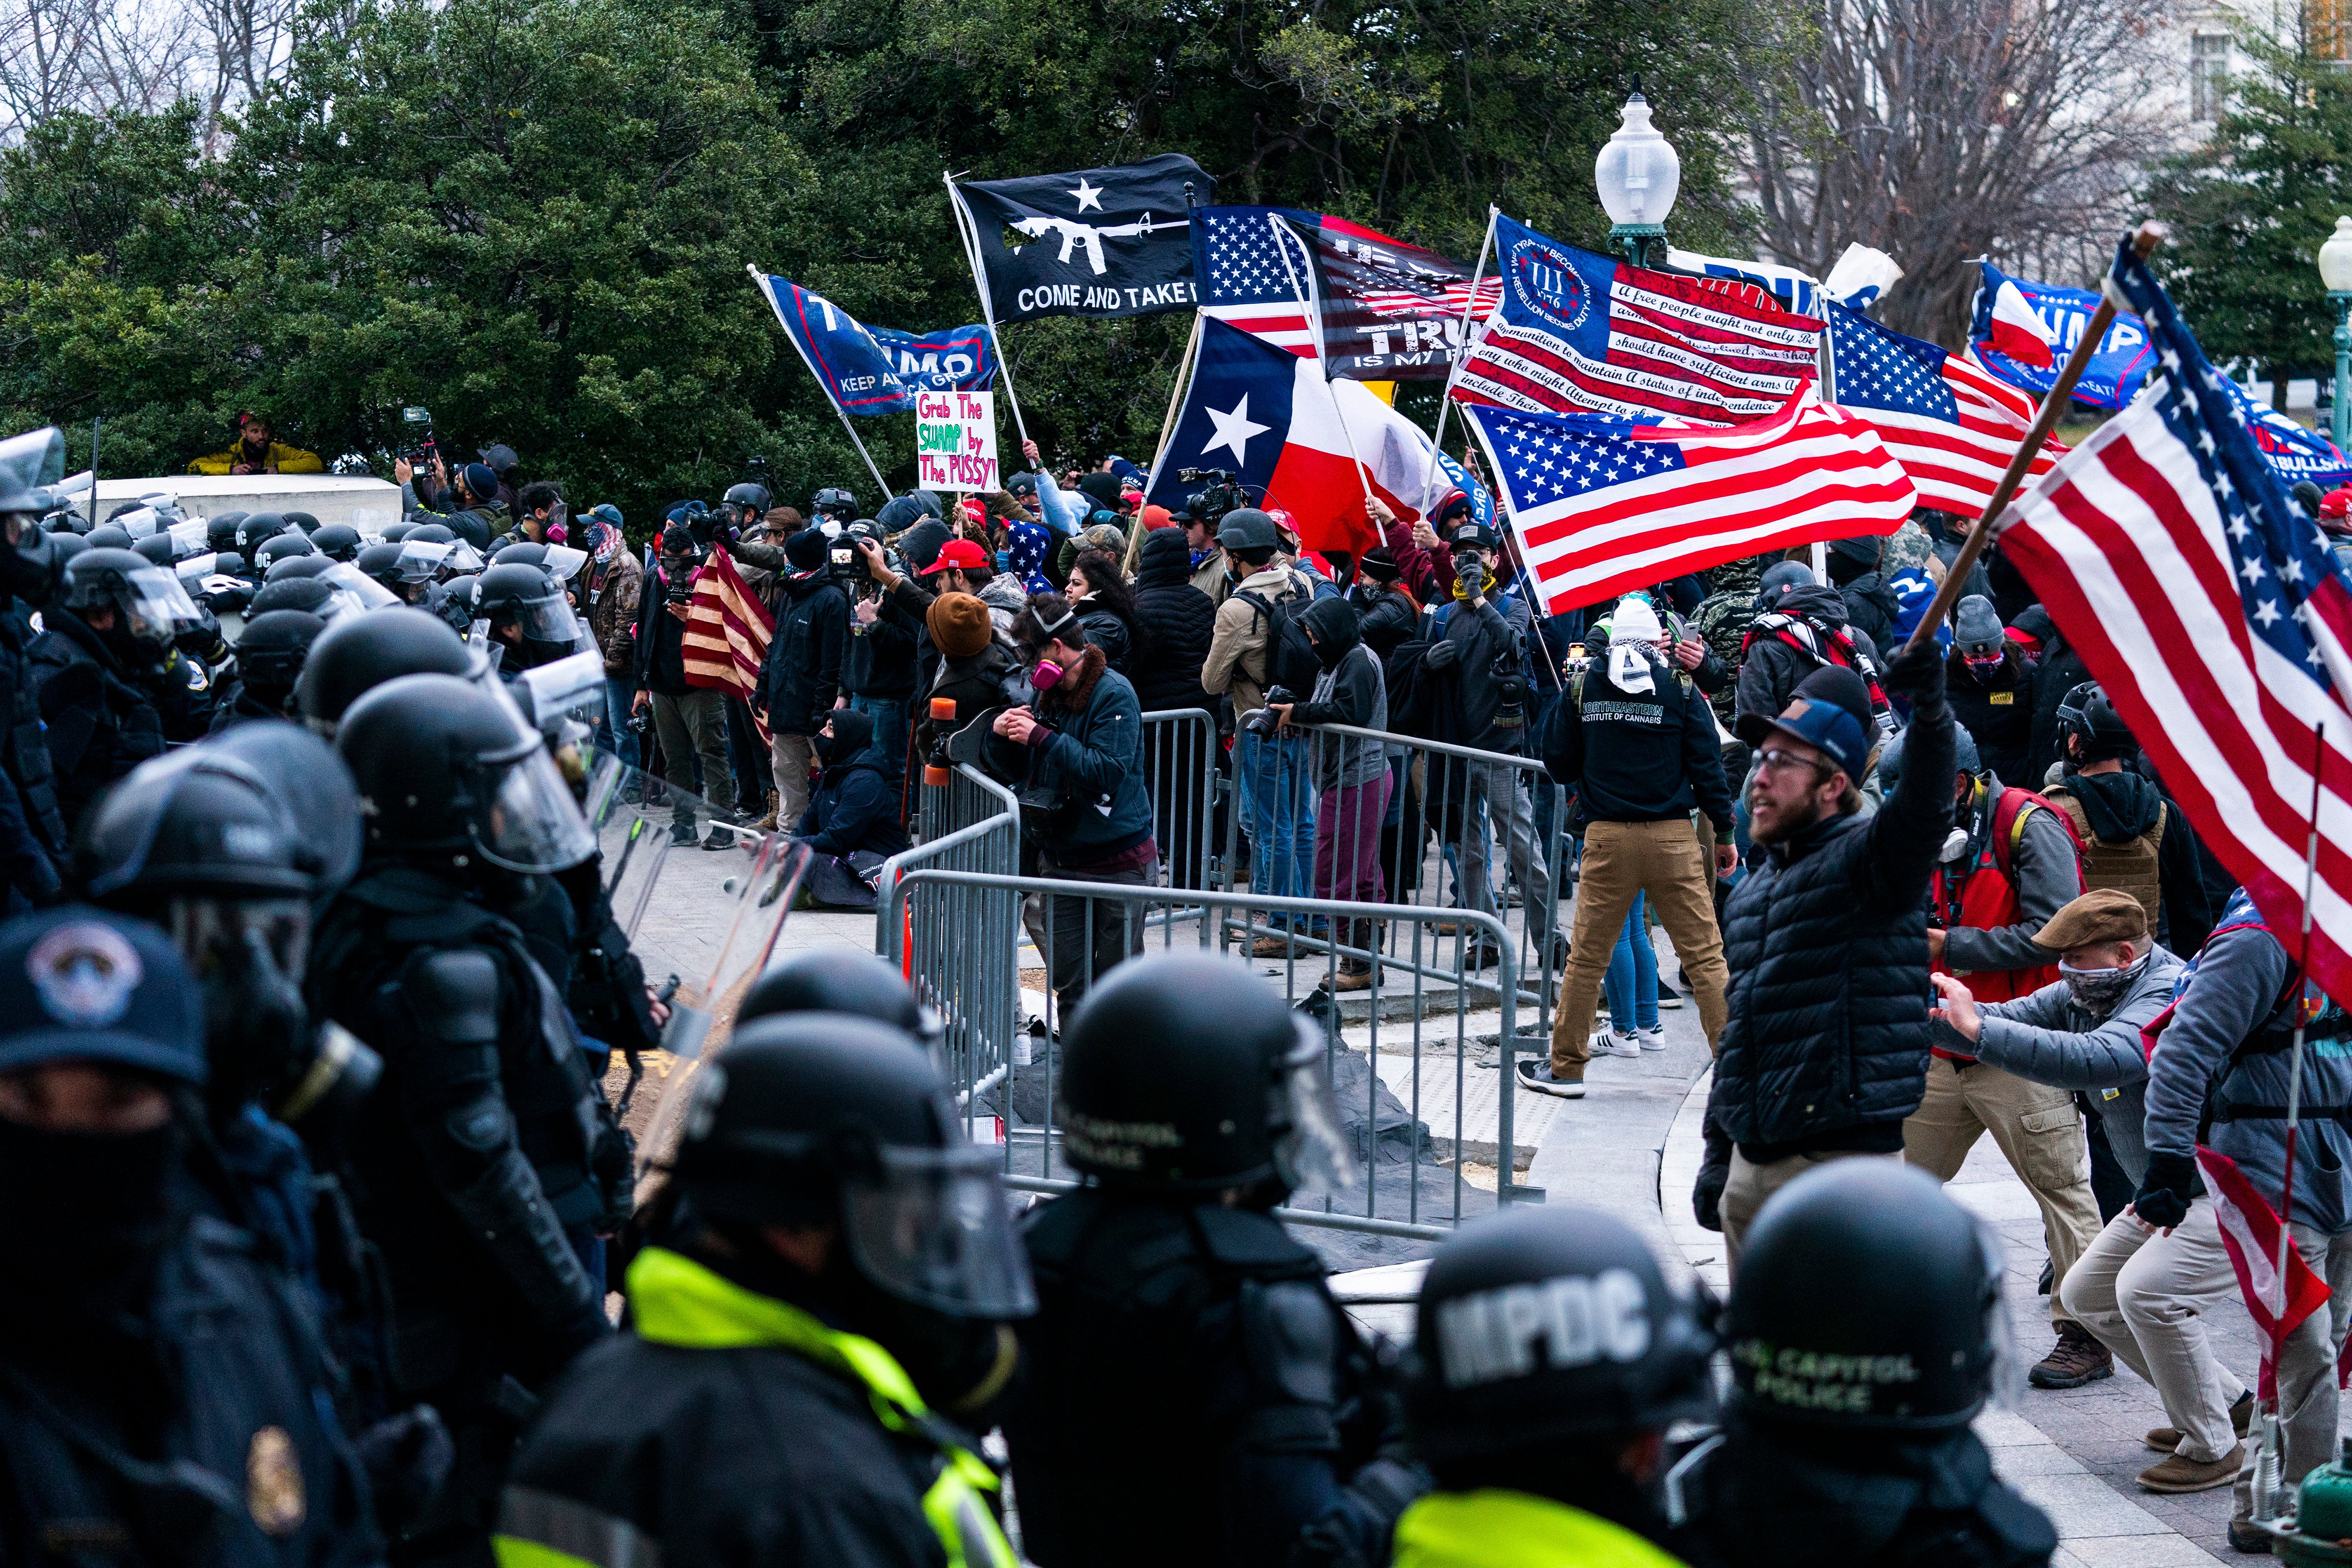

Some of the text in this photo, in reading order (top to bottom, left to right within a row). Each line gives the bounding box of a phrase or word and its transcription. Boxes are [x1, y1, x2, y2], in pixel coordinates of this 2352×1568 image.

[1018, 282, 1198, 311] COME AND TAKE I
[1512, 276, 1590, 330] REBELLION BECOMES DUTY
[1535, 287, 1561, 309] 1776
[1619, 285, 1815, 345] A free people ought not only Be
[1354, 356, 1384, 367] IS
[1395, 350, 1434, 366] MY
[1615, 337, 1655, 355] should
[1657, 346, 1686, 363] have
[1689, 358, 1748, 385] sufficient
[1751, 378, 1781, 390] arms
[1757, 349, 1778, 358] But
[1782, 350, 1811, 364] They
[840, 375, 876, 392] KEEP
[1461, 374, 1540, 412] include Their
[1478, 349, 1501, 363] any
[1504, 357, 1528, 372] who
[1530, 369, 1563, 390] might
[1565, 386, 1613, 412] Attempt
[1615, 405, 1627, 414] to
[1563, 347, 1572, 358] to
[1574, 356, 1622, 380] maintain
[1626, 371, 1639, 383] A
[1640, 375, 1674, 392] status
[1678, 385, 1692, 399] of
[1696, 388, 1775, 411] independence
[919, 394, 982, 419] Grab The
[919, 423, 984, 456] SWAMP by
[920, 454, 996, 490] The PUSSY!
[1581, 713, 1613, 722] NSTITUTE
[1625, 714, 1661, 724] CANNABIS
[1435, 1266, 1652, 1391] MPDC
